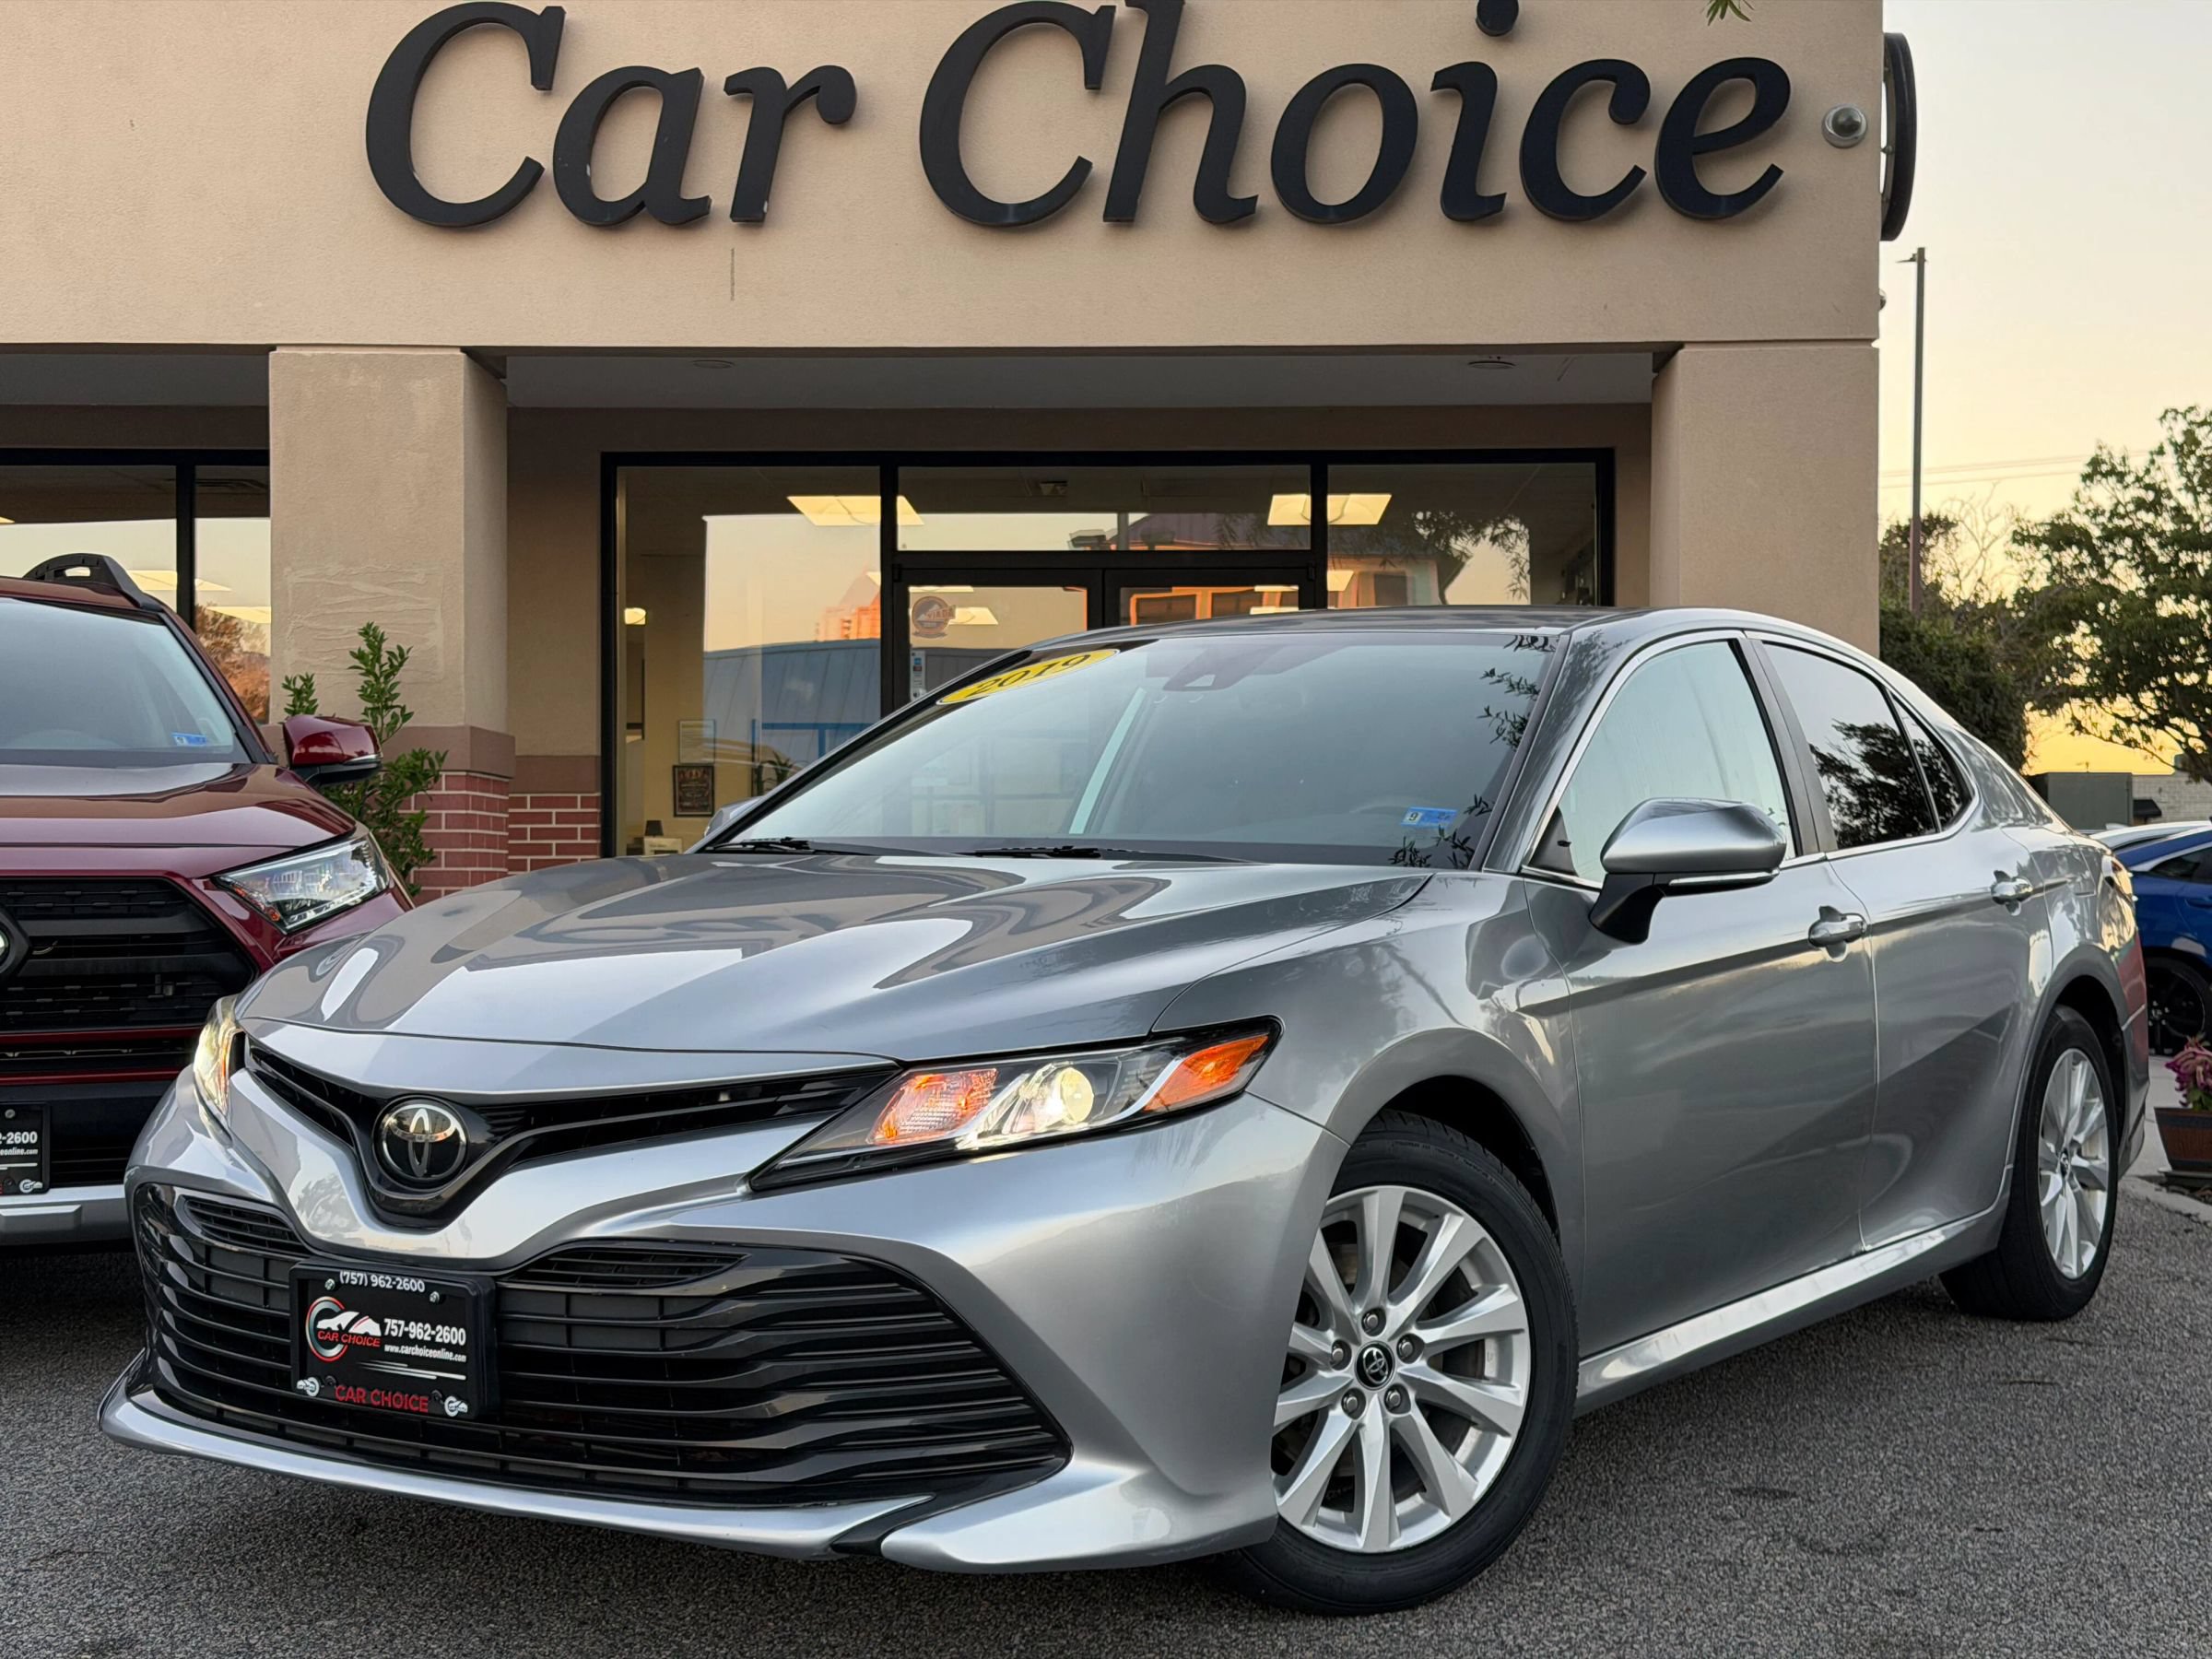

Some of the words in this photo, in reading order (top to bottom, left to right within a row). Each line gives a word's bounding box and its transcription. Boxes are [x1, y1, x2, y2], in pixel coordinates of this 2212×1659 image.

[366, 1, 857, 228] Car
[919, 0, 1792, 227] Choice
[965, 654, 1091, 698] 2019
[339, 1270, 368, 1286] (757)
[370, 1274, 426, 1293] 962-2600
[317, 1330, 339, 1342] CAR
[341, 1334, 381, 1347] CHOICE
[383, 1318, 466, 1347] 757-962-2600
[383, 1344, 467, 1362] www.carchoiceonline.com
[335, 1385, 366, 1403] CAR
[370, 1390, 429, 1413] CHOICE
